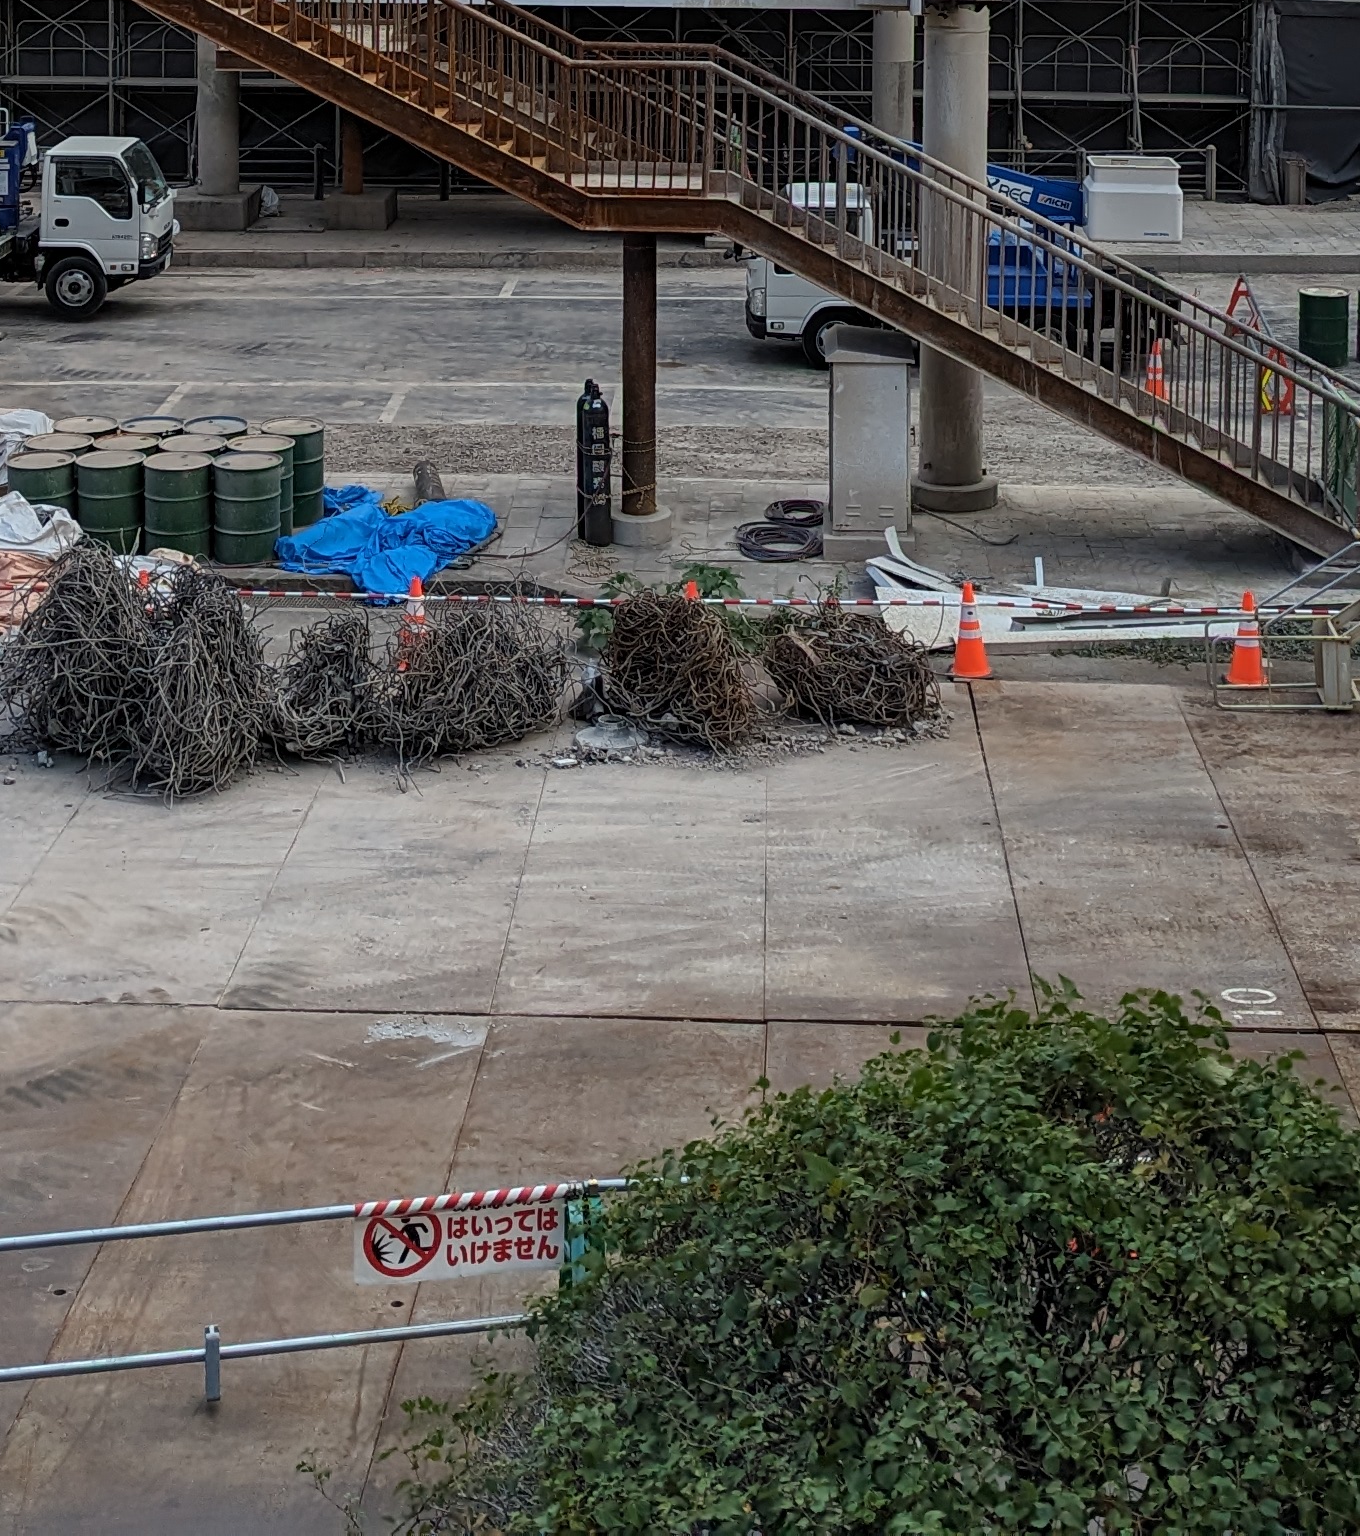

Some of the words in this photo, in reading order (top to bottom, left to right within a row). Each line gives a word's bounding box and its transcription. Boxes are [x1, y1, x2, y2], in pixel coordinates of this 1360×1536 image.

[447, 1207, 559, 1239] はいっては
[446, 1235, 559, 1266] いけません
